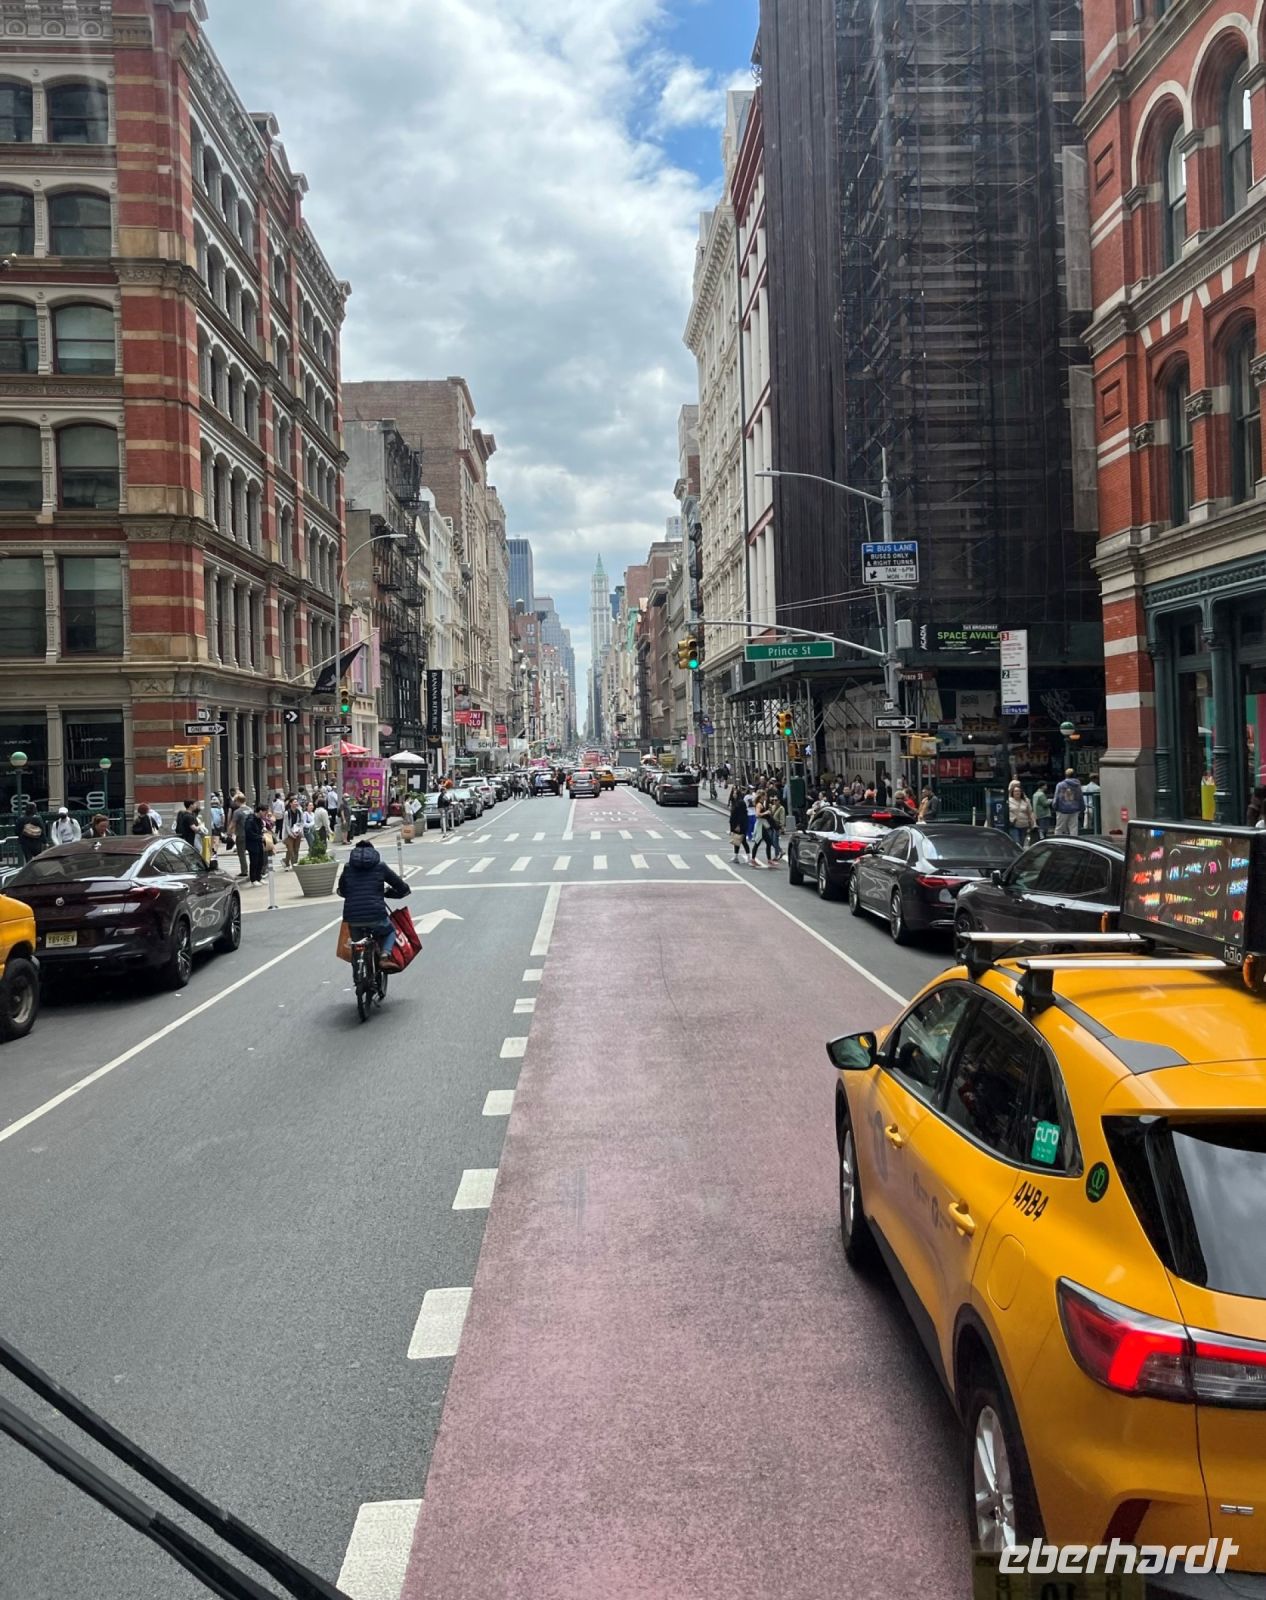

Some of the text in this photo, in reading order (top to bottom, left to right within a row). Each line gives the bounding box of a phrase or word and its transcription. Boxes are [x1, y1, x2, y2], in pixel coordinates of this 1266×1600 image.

[937, 631, 967, 640] SPACE
[768, 646, 812, 657] Prince St
[1034, 1126, 1060, 1146] curb
[1013, 1180, 1050, 1223] 4HB4
